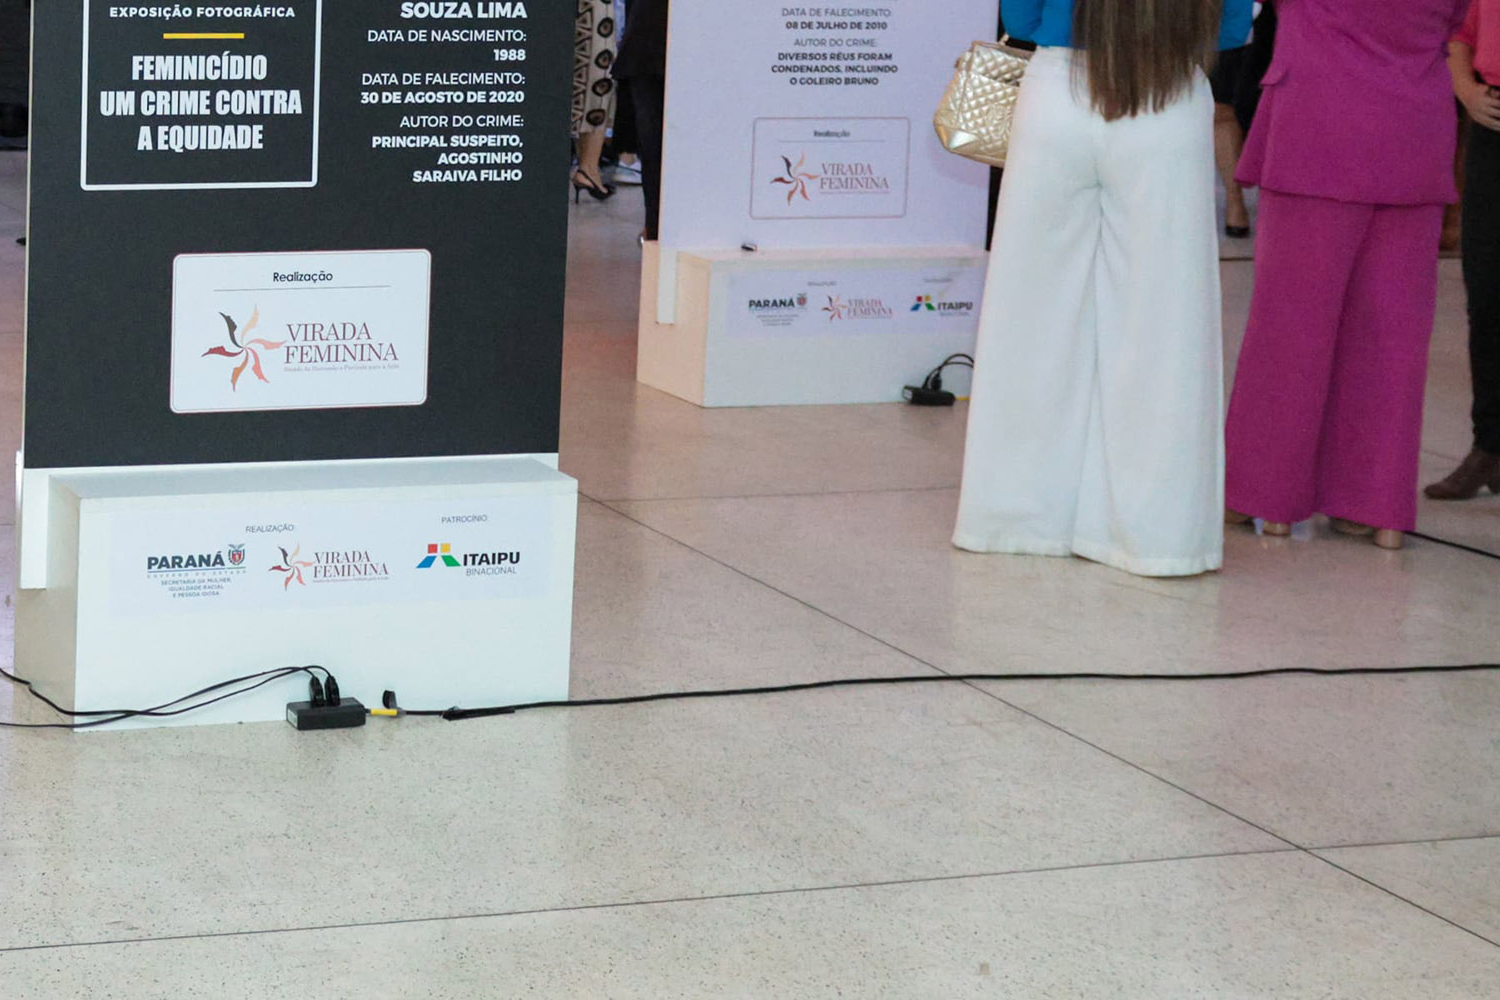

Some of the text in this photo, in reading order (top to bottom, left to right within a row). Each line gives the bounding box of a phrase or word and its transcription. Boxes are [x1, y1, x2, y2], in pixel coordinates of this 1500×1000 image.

[109, 4, 296, 20] EXPOSIÇÃO FOTOGRÁFICA
[400, 1, 528, 18] SOUZA LIMA
[782, 8, 807, 17] DATA
[809, 8, 822, 17] DE
[800, 21, 814, 30] DE
[816, 21, 848, 30] JULHO
[850, 21, 863, 30] DE
[367, 29, 527, 42] DATA DE NASCIMENTO:
[794, 39, 827, 47] AUTOR
[829, 39, 844, 47] DO
[493, 49, 526, 61] 1988
[778, 53, 828, 61] DIVERSOS
[857, 53, 893, 61] FORAM
[132, 51, 267, 81] FEMINICÍDIO
[845, 65, 898, 73] INCLUINDO
[362, 73, 525, 85] DATA DE FALECIMENTO:
[790, 77, 797, 85] O
[844, 77, 880, 85] BRUNO
[100, 89, 302, 116] UM CRIME CONTRA
[361, 91, 524, 104] 30 DE AGOSTO DE 2020
[400, 115, 524, 128] AUTOR DO CRIME:
[137, 125, 263, 152] A EQUIDADE
[372, 135, 523, 148] PRINCIPAL SUSPEITO,
[437, 152, 523, 165] AGOSTINHO
[413, 169, 522, 182] SARAIVA FILHO
[822, 163, 873, 176] VIRADA
[820, 177, 889, 189] FEMININA
[273, 270, 333, 283] Realização
[938, 302, 973, 310] ITAIPU
[287, 322, 372, 342] VIRADA
[284, 343, 399, 364] FEMININA
[441, 514, 488, 523] PATROCÍNIO
[147, 551, 225, 569] PARANÁ
[315, 550, 371, 564] VIRADA
[463, 552, 520, 566] ITAIPU
[314, 563, 389, 578] FEMININA
[466, 566, 517, 577] BINACIONAL
